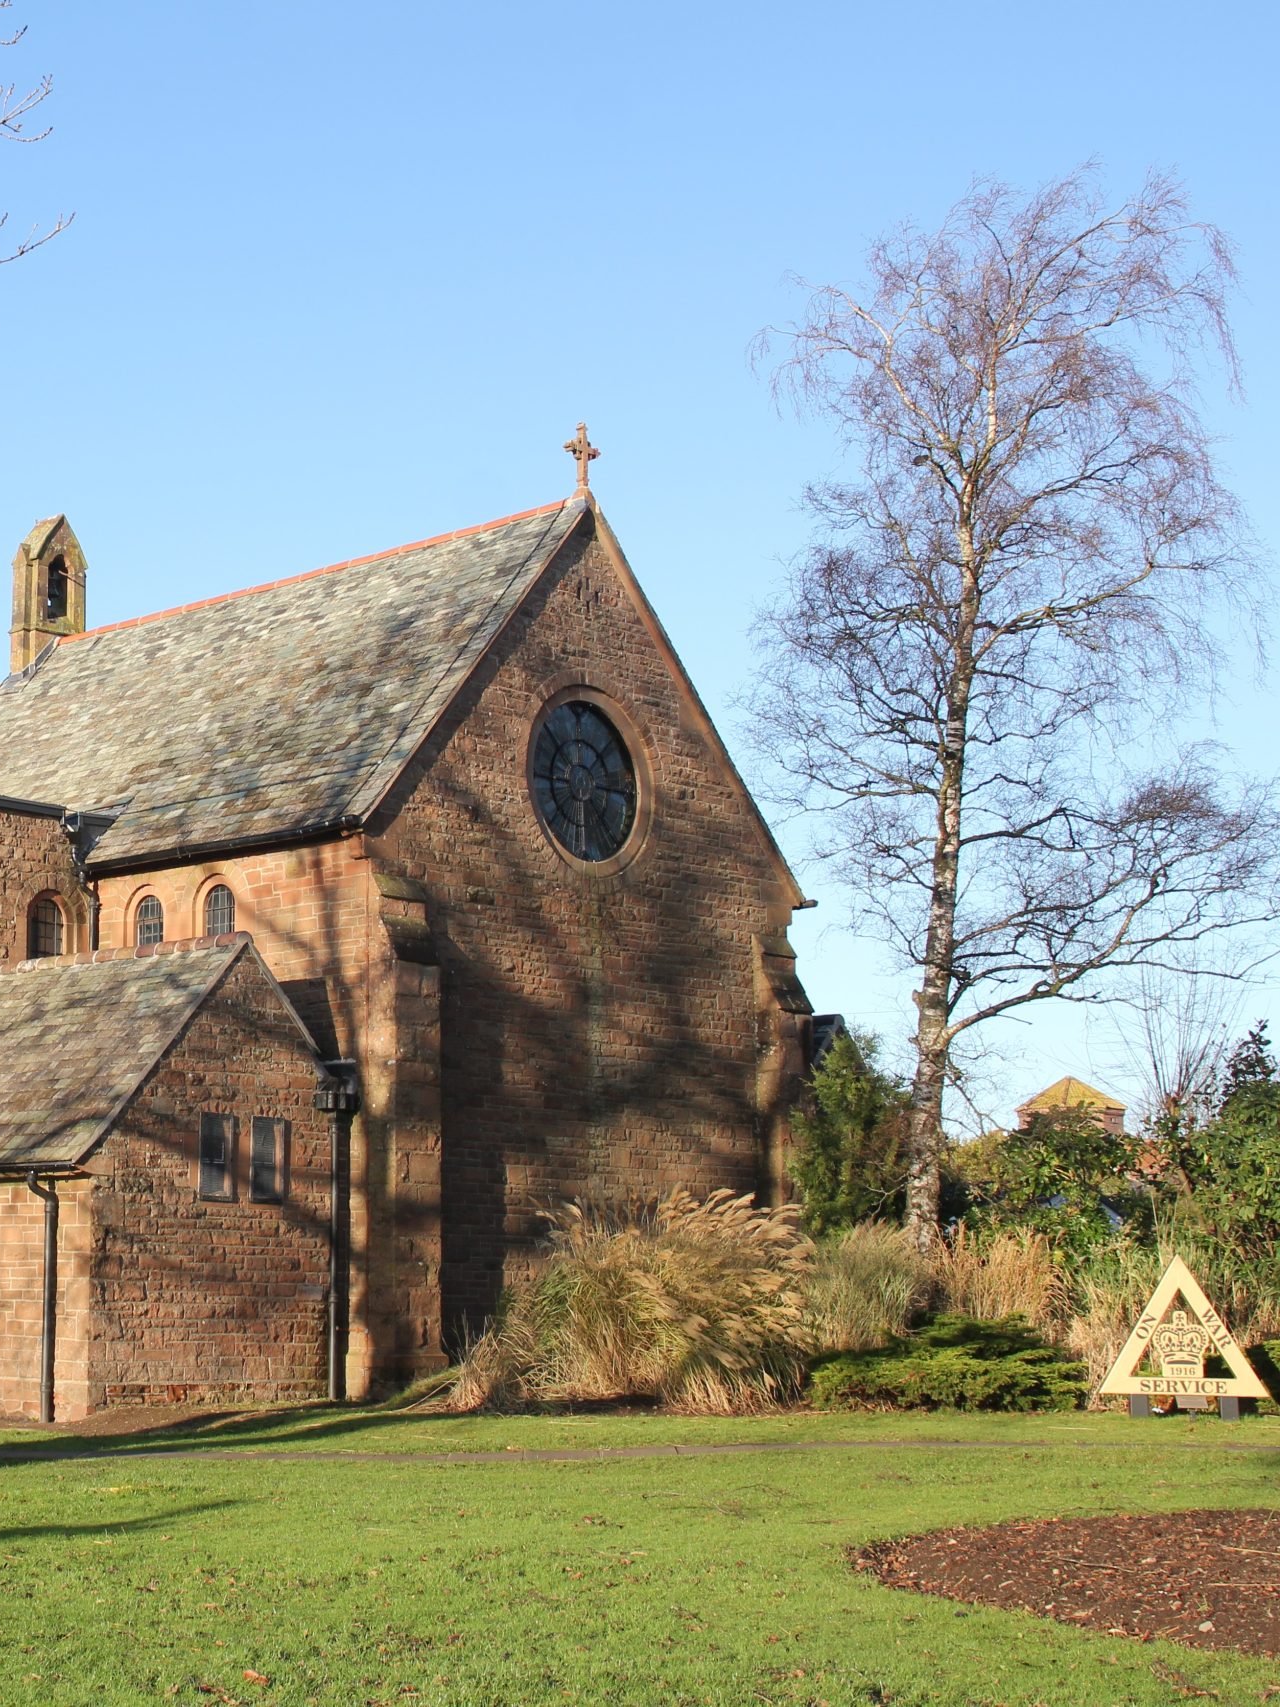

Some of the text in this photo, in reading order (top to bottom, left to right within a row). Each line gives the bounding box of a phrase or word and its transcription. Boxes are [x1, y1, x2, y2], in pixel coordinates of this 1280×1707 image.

[1135, 1313, 1157, 1340] ON
[1202, 1308, 1232, 1350] WAR
[1170, 1367, 1196, 1376] 1916
[1140, 1379, 1227, 1394] SERVICE
